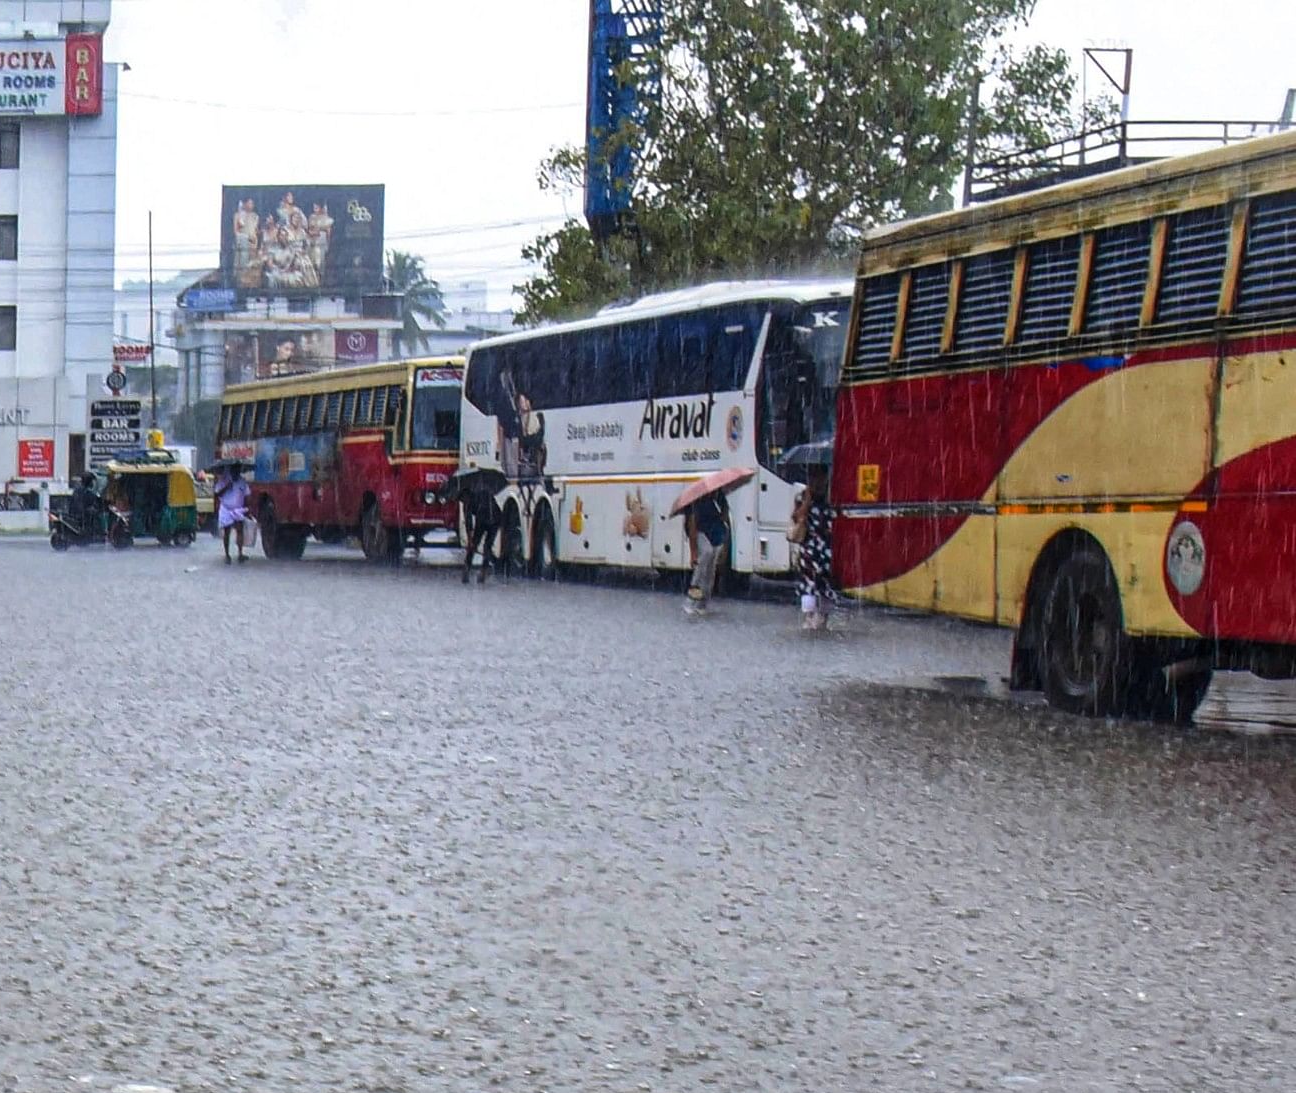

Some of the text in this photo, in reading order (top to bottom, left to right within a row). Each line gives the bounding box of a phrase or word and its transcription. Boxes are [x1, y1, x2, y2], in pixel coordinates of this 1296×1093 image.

[3, 75, 57, 89] ROOMS
[75, 49, 90, 101] BAR
[95, 431, 136, 442] ROOMS
